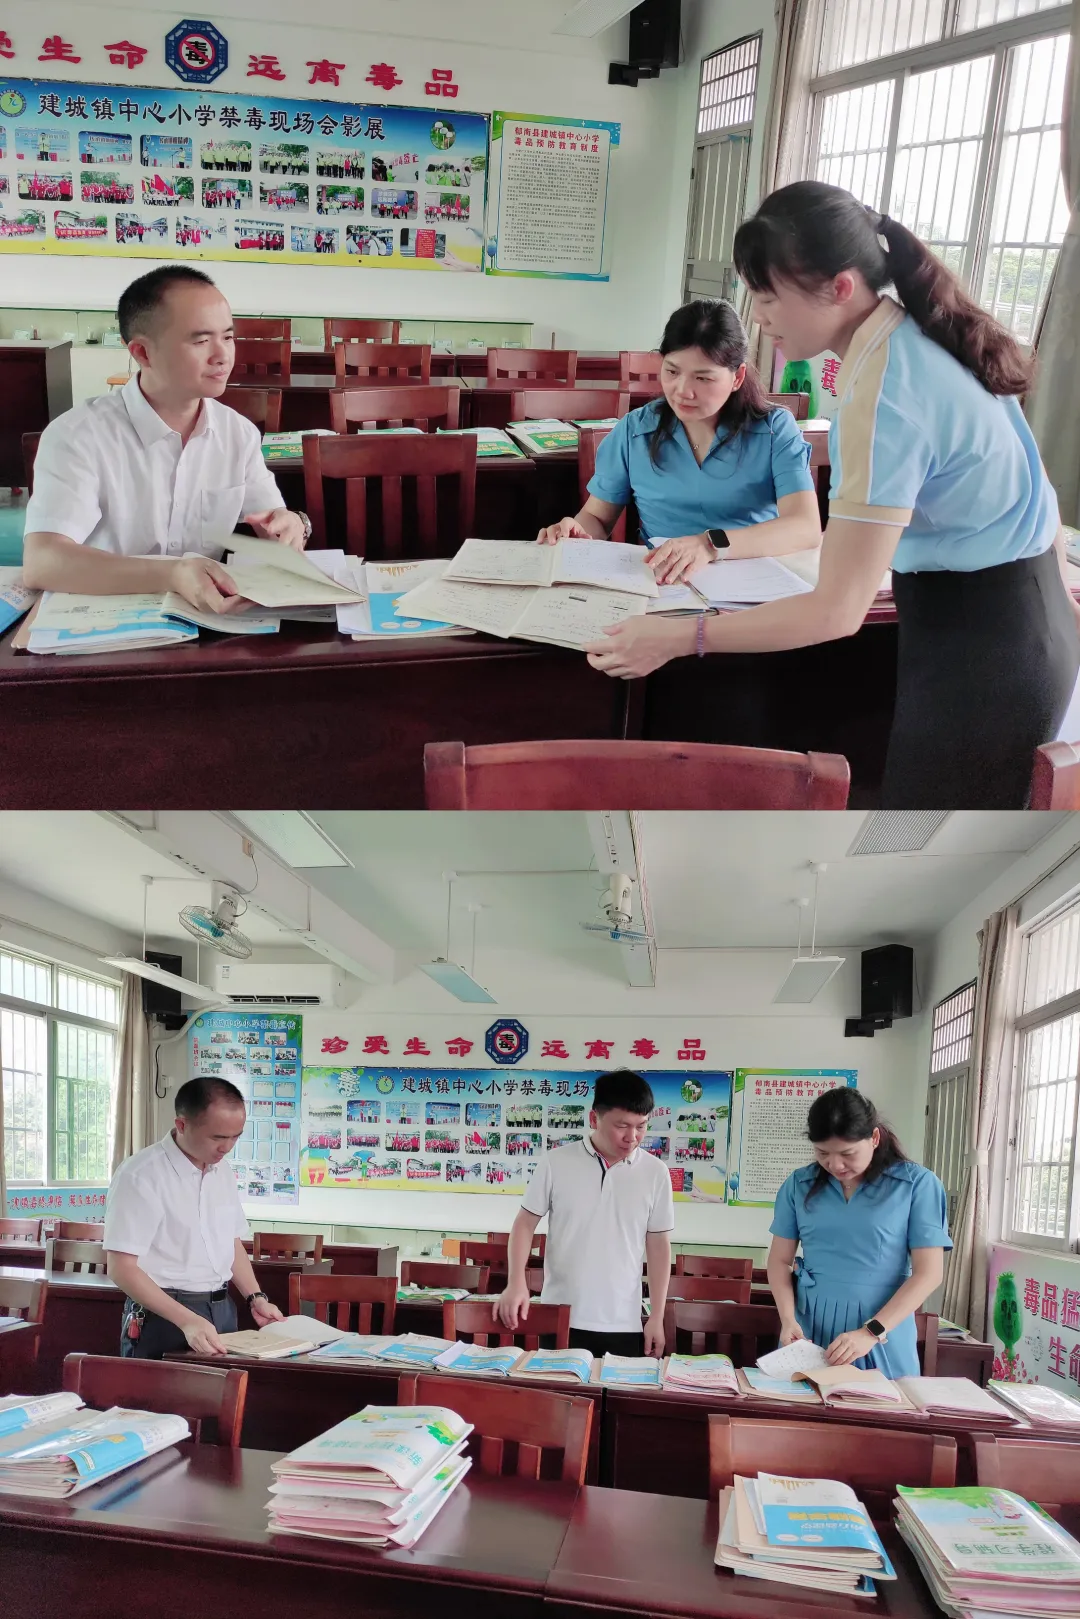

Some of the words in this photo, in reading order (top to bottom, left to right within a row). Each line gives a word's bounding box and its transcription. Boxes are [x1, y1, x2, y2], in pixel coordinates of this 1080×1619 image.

[185, 41, 209, 65] 毒
[247, 55, 459, 97] 远离毒品
[37, 93, 386, 140] 建城镇中心小学禁毒现场会影展
[514, 137, 599, 153] 毒品预防教育制度
[515, 127, 600, 143] 郁南县建城镇中心小学
[321, 1036, 474, 1057] 珍爱生命
[498, 1034, 516, 1051] 毒
[541, 1038, 706, 1061] 远离毒品
[401, 1077, 597, 1098] 建城镇中心小学禁毒现场
